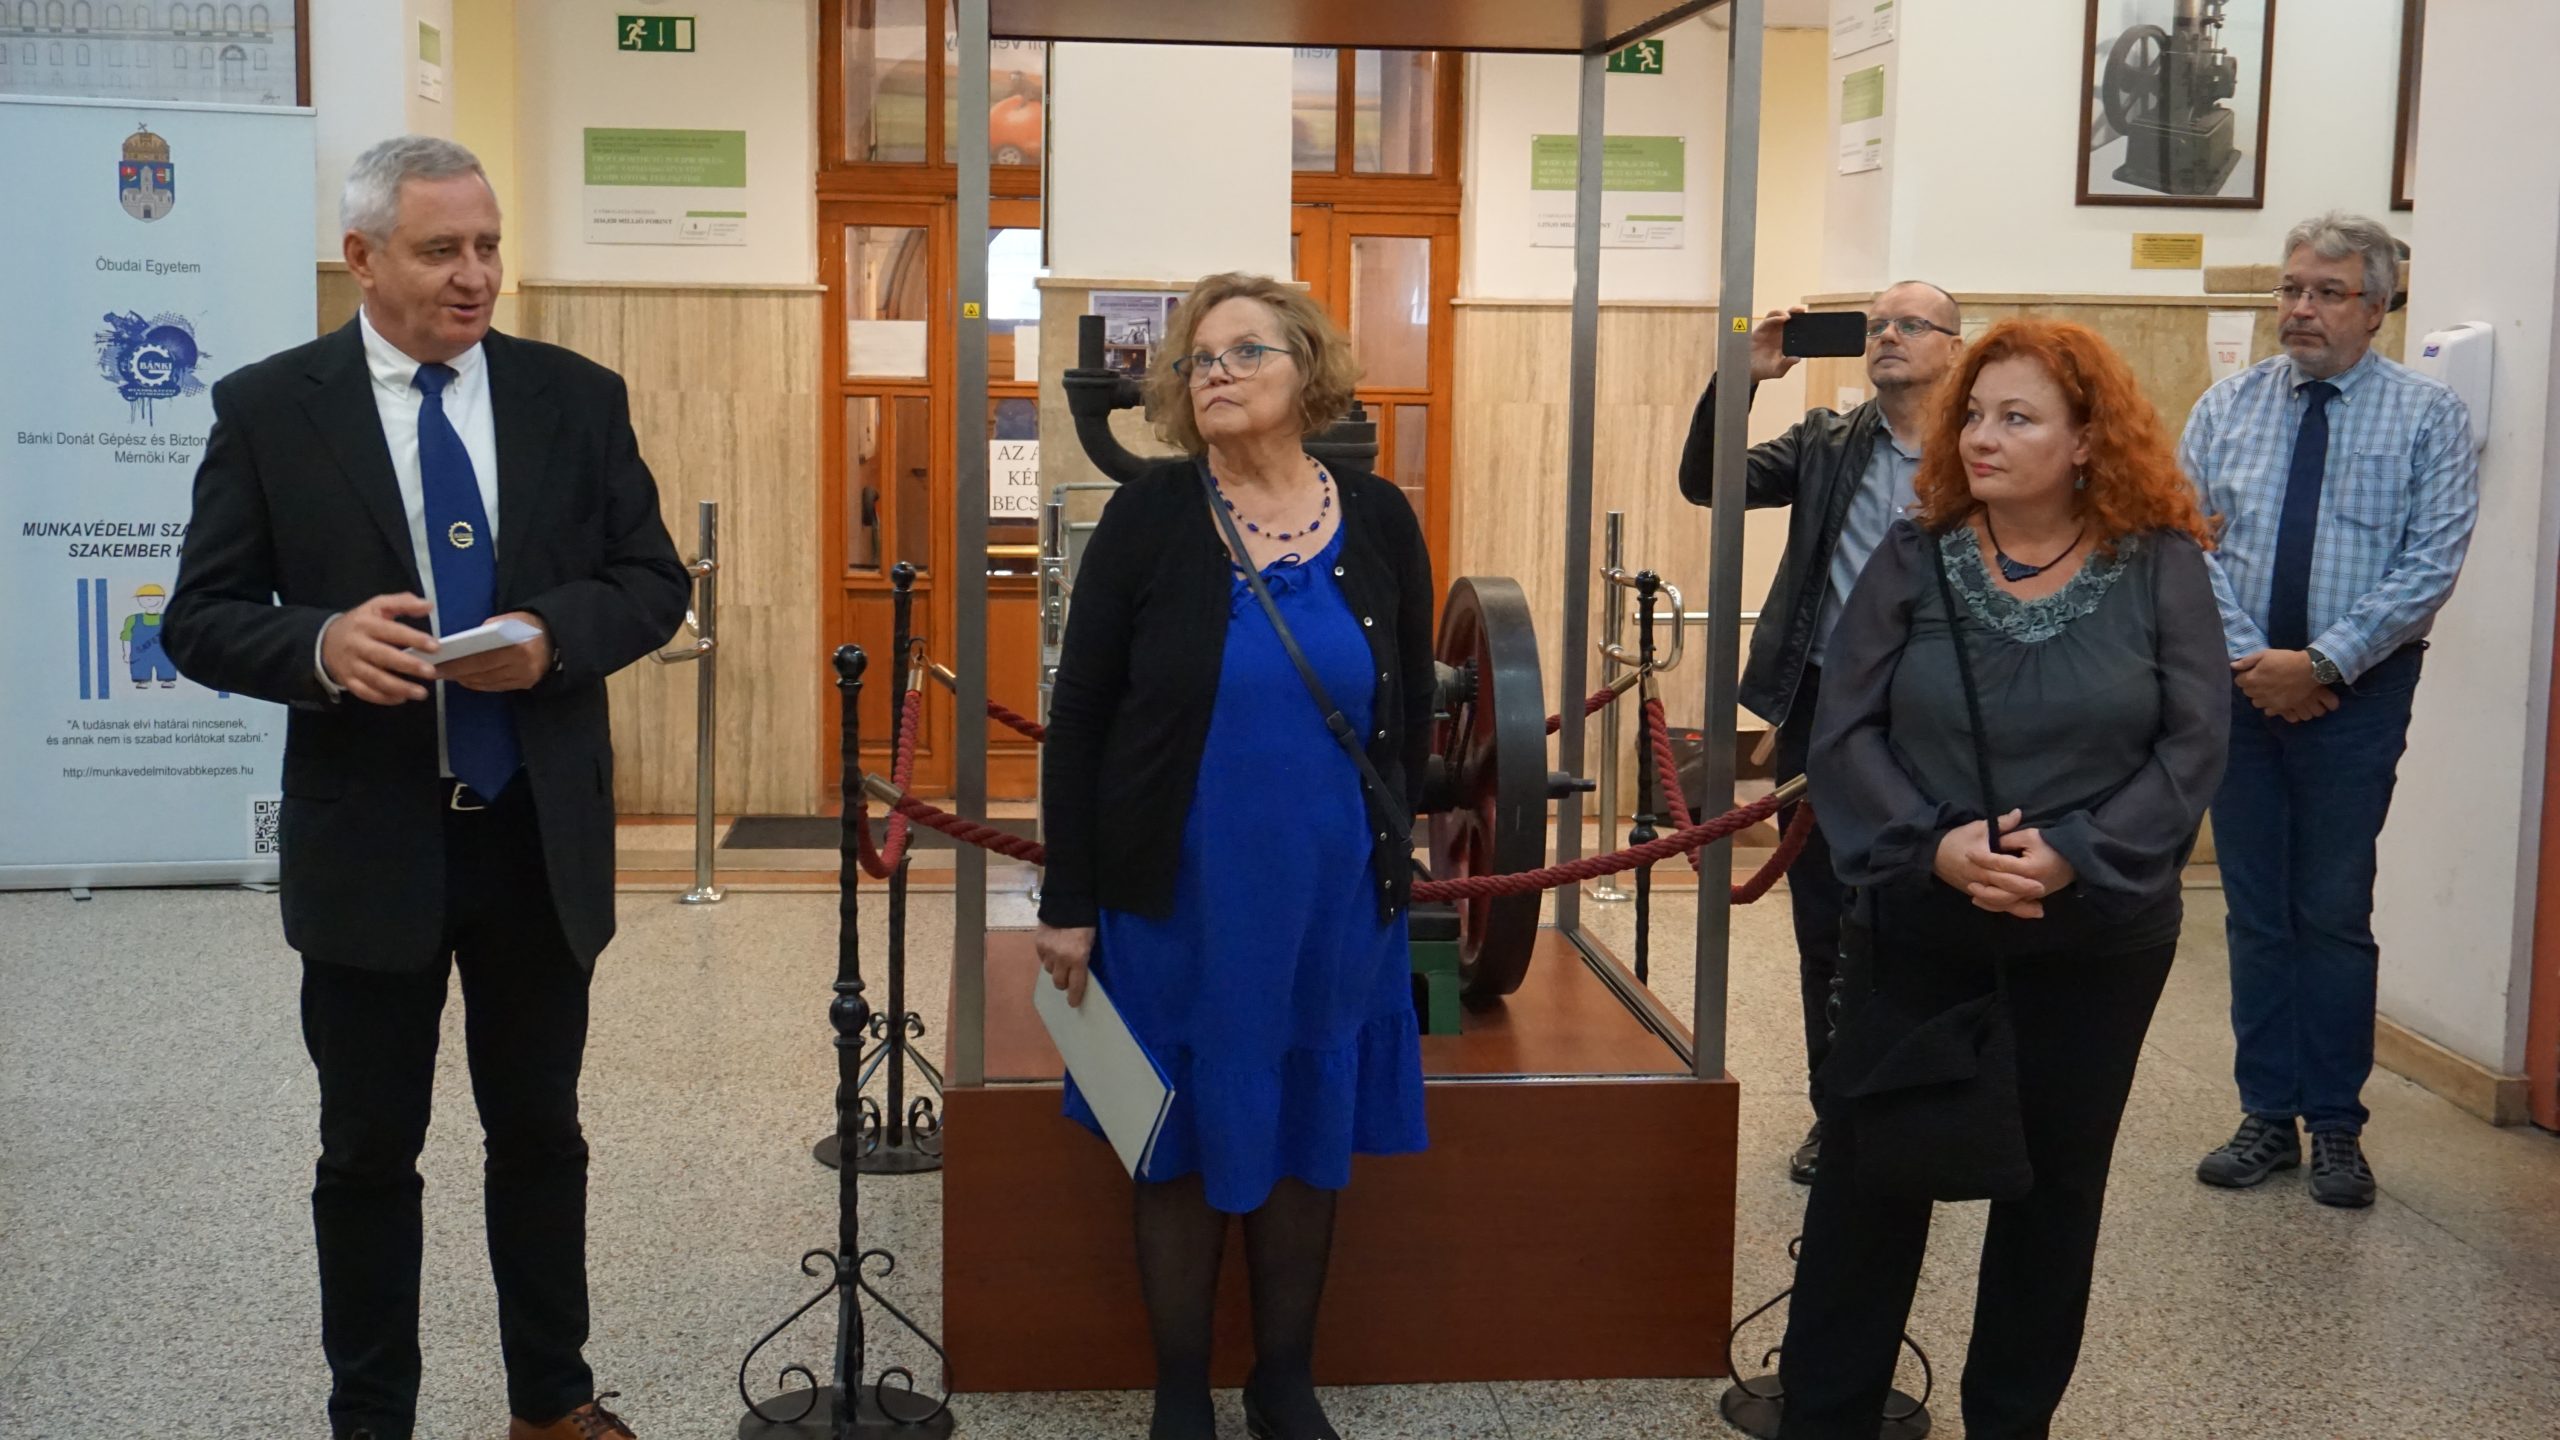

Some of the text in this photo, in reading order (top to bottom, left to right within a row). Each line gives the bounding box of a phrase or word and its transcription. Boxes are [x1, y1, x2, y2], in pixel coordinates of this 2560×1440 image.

[96, 256, 201, 275] Óbudai Egyetem
[139, 360, 172, 370] BÁNKI
[17, 431, 53, 445] Bánki
[56, 432, 95, 446] Donát
[98, 432, 147, 448] Gépész
[151, 433, 166, 446] és
[114, 450, 191, 464] Mérnöki Kar
[998, 445, 1025, 461] AZ
[992, 496, 1040, 511] BECS
[22, 519, 156, 537] MUNKAVÉDELMI
[68, 544, 171, 558] SZAKEMBER
[83, 718, 130, 730] tudásnak
[133, 718, 151, 729] elvi
[154, 718, 189, 729] határai
[192, 718, 247, 731] nincsenek,
[46, 733, 268, 745] és annak nem is szabad korlátokat szabni."
[63, 765, 254, 779] http://munkavedelmitovabbkepzes.hu
